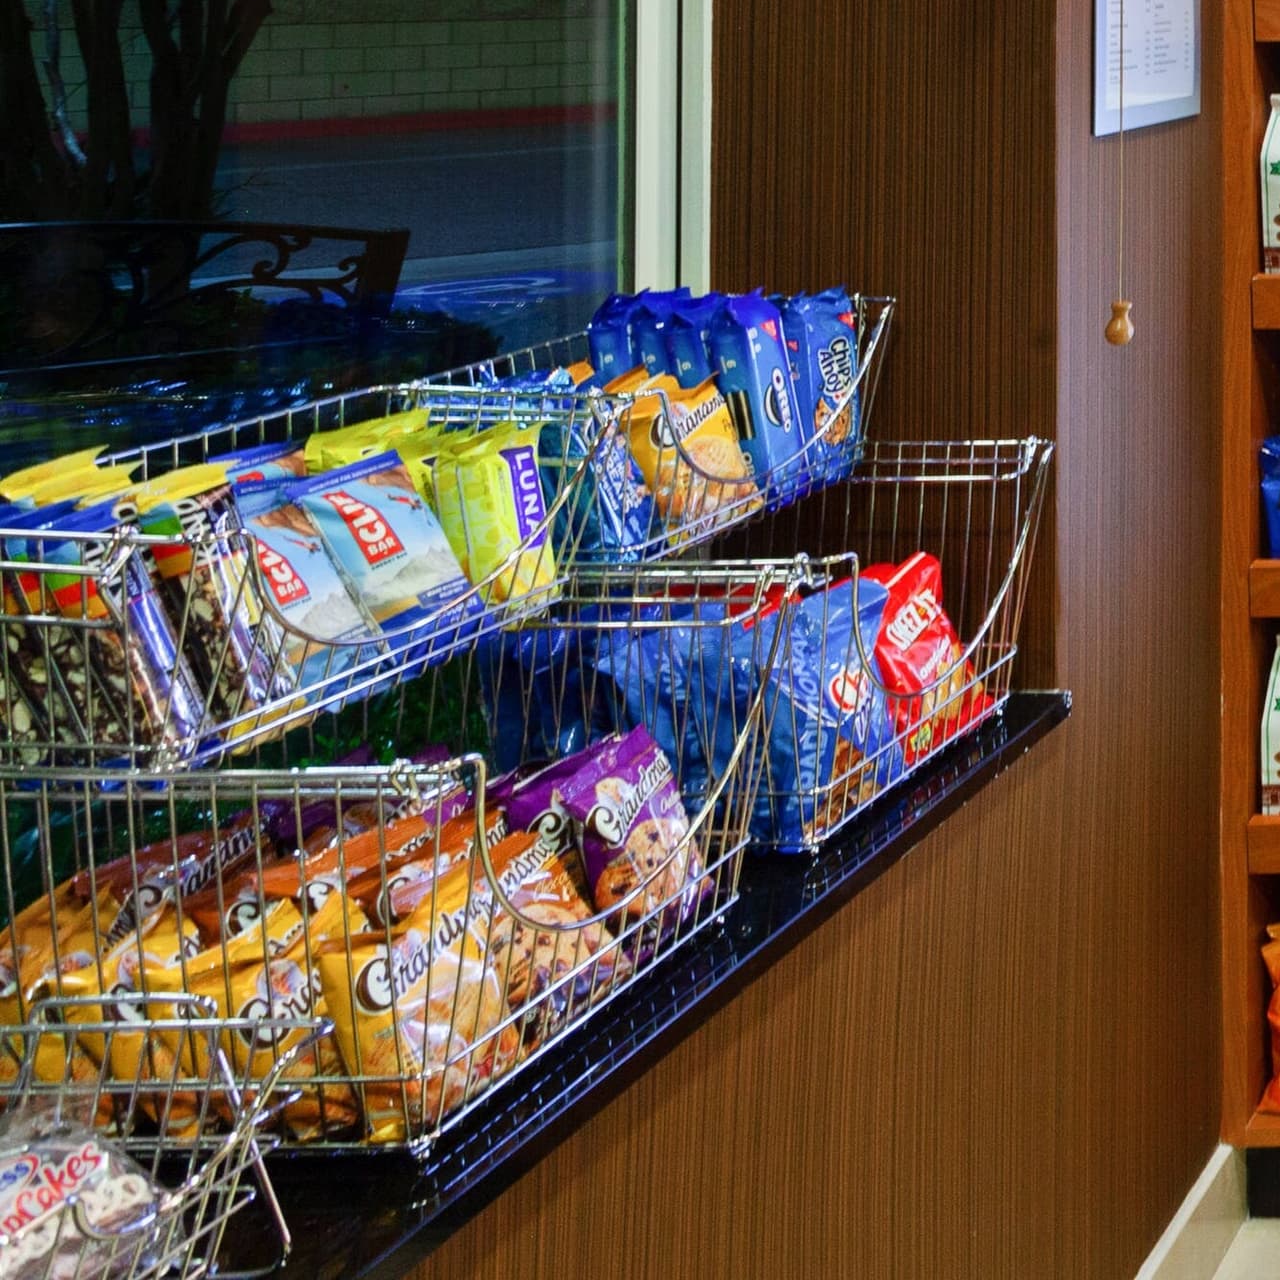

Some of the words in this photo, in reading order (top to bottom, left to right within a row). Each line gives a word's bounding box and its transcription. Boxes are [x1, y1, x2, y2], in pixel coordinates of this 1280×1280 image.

[772, 367, 792, 433] OREO
[327, 492, 387, 544] CLIF
[513, 450, 545, 538] LUNA
[367, 536, 397, 557] BAR
[276, 579, 303, 597] BAR
